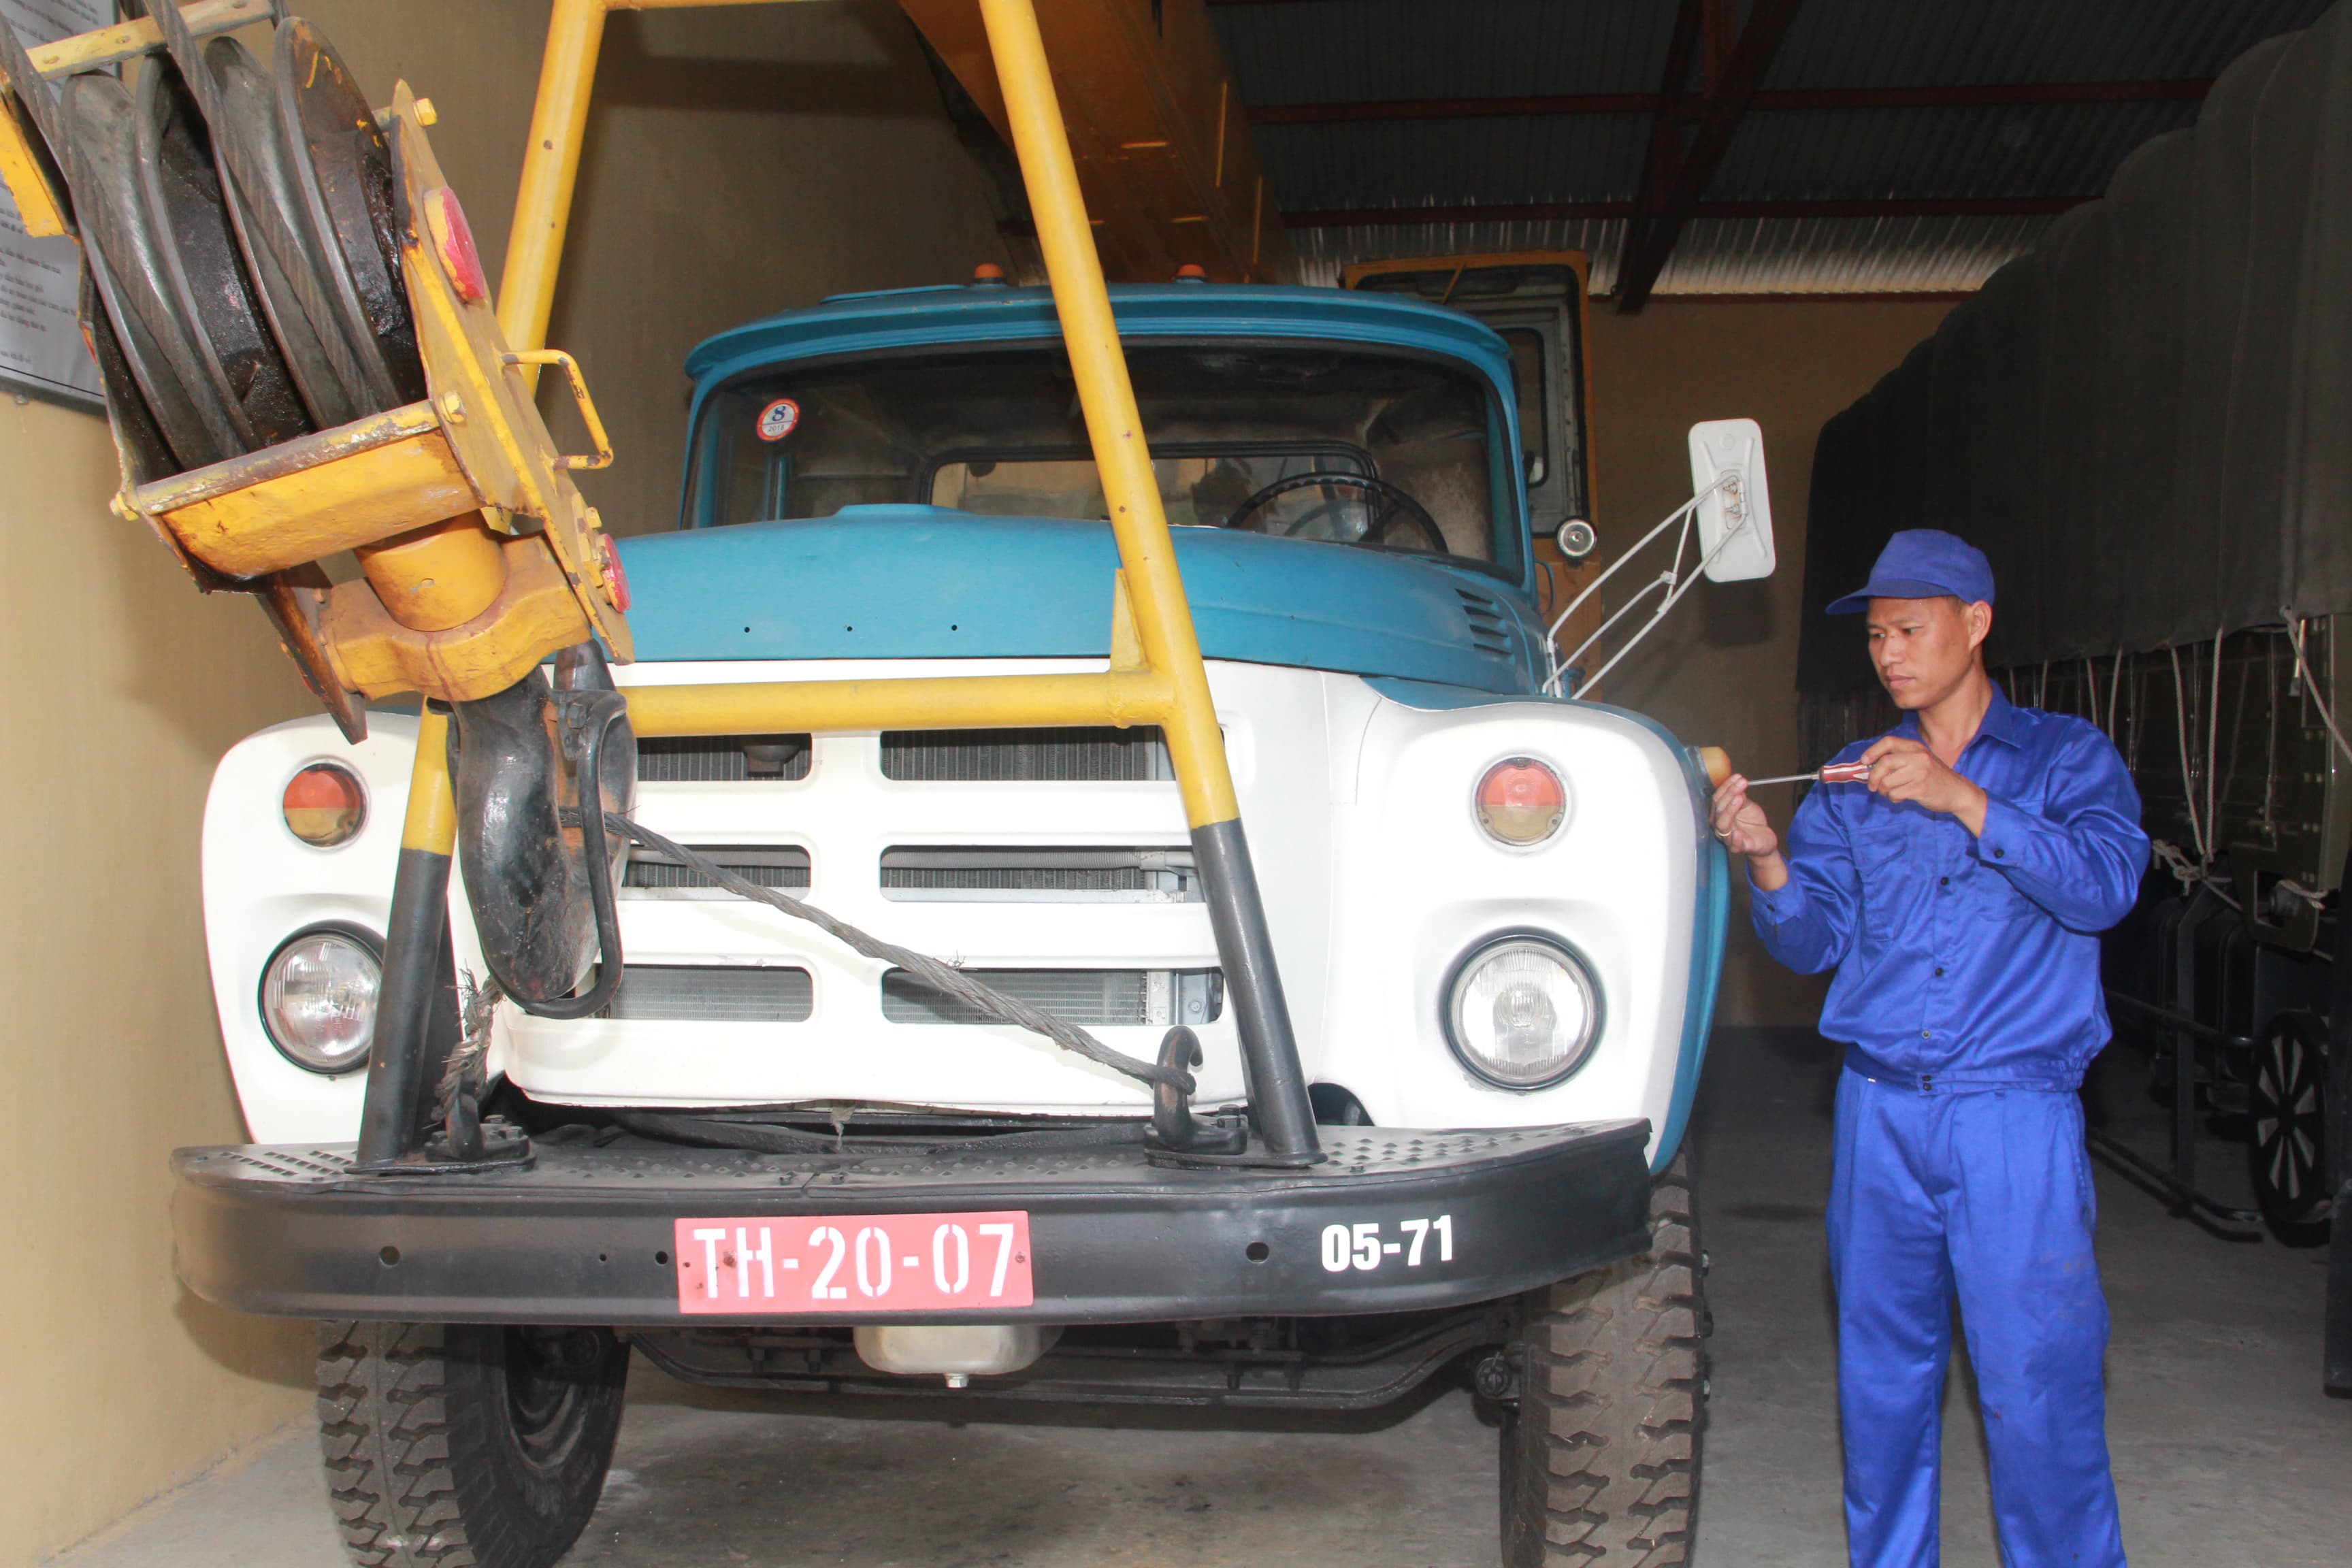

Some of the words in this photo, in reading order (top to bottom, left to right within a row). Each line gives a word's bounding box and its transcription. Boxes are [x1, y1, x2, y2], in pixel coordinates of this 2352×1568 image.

[772, 405, 786, 421] 8
[693, 1223, 1014, 1299] TH-20-07
[1322, 1214, 1452, 1272] 05-71
